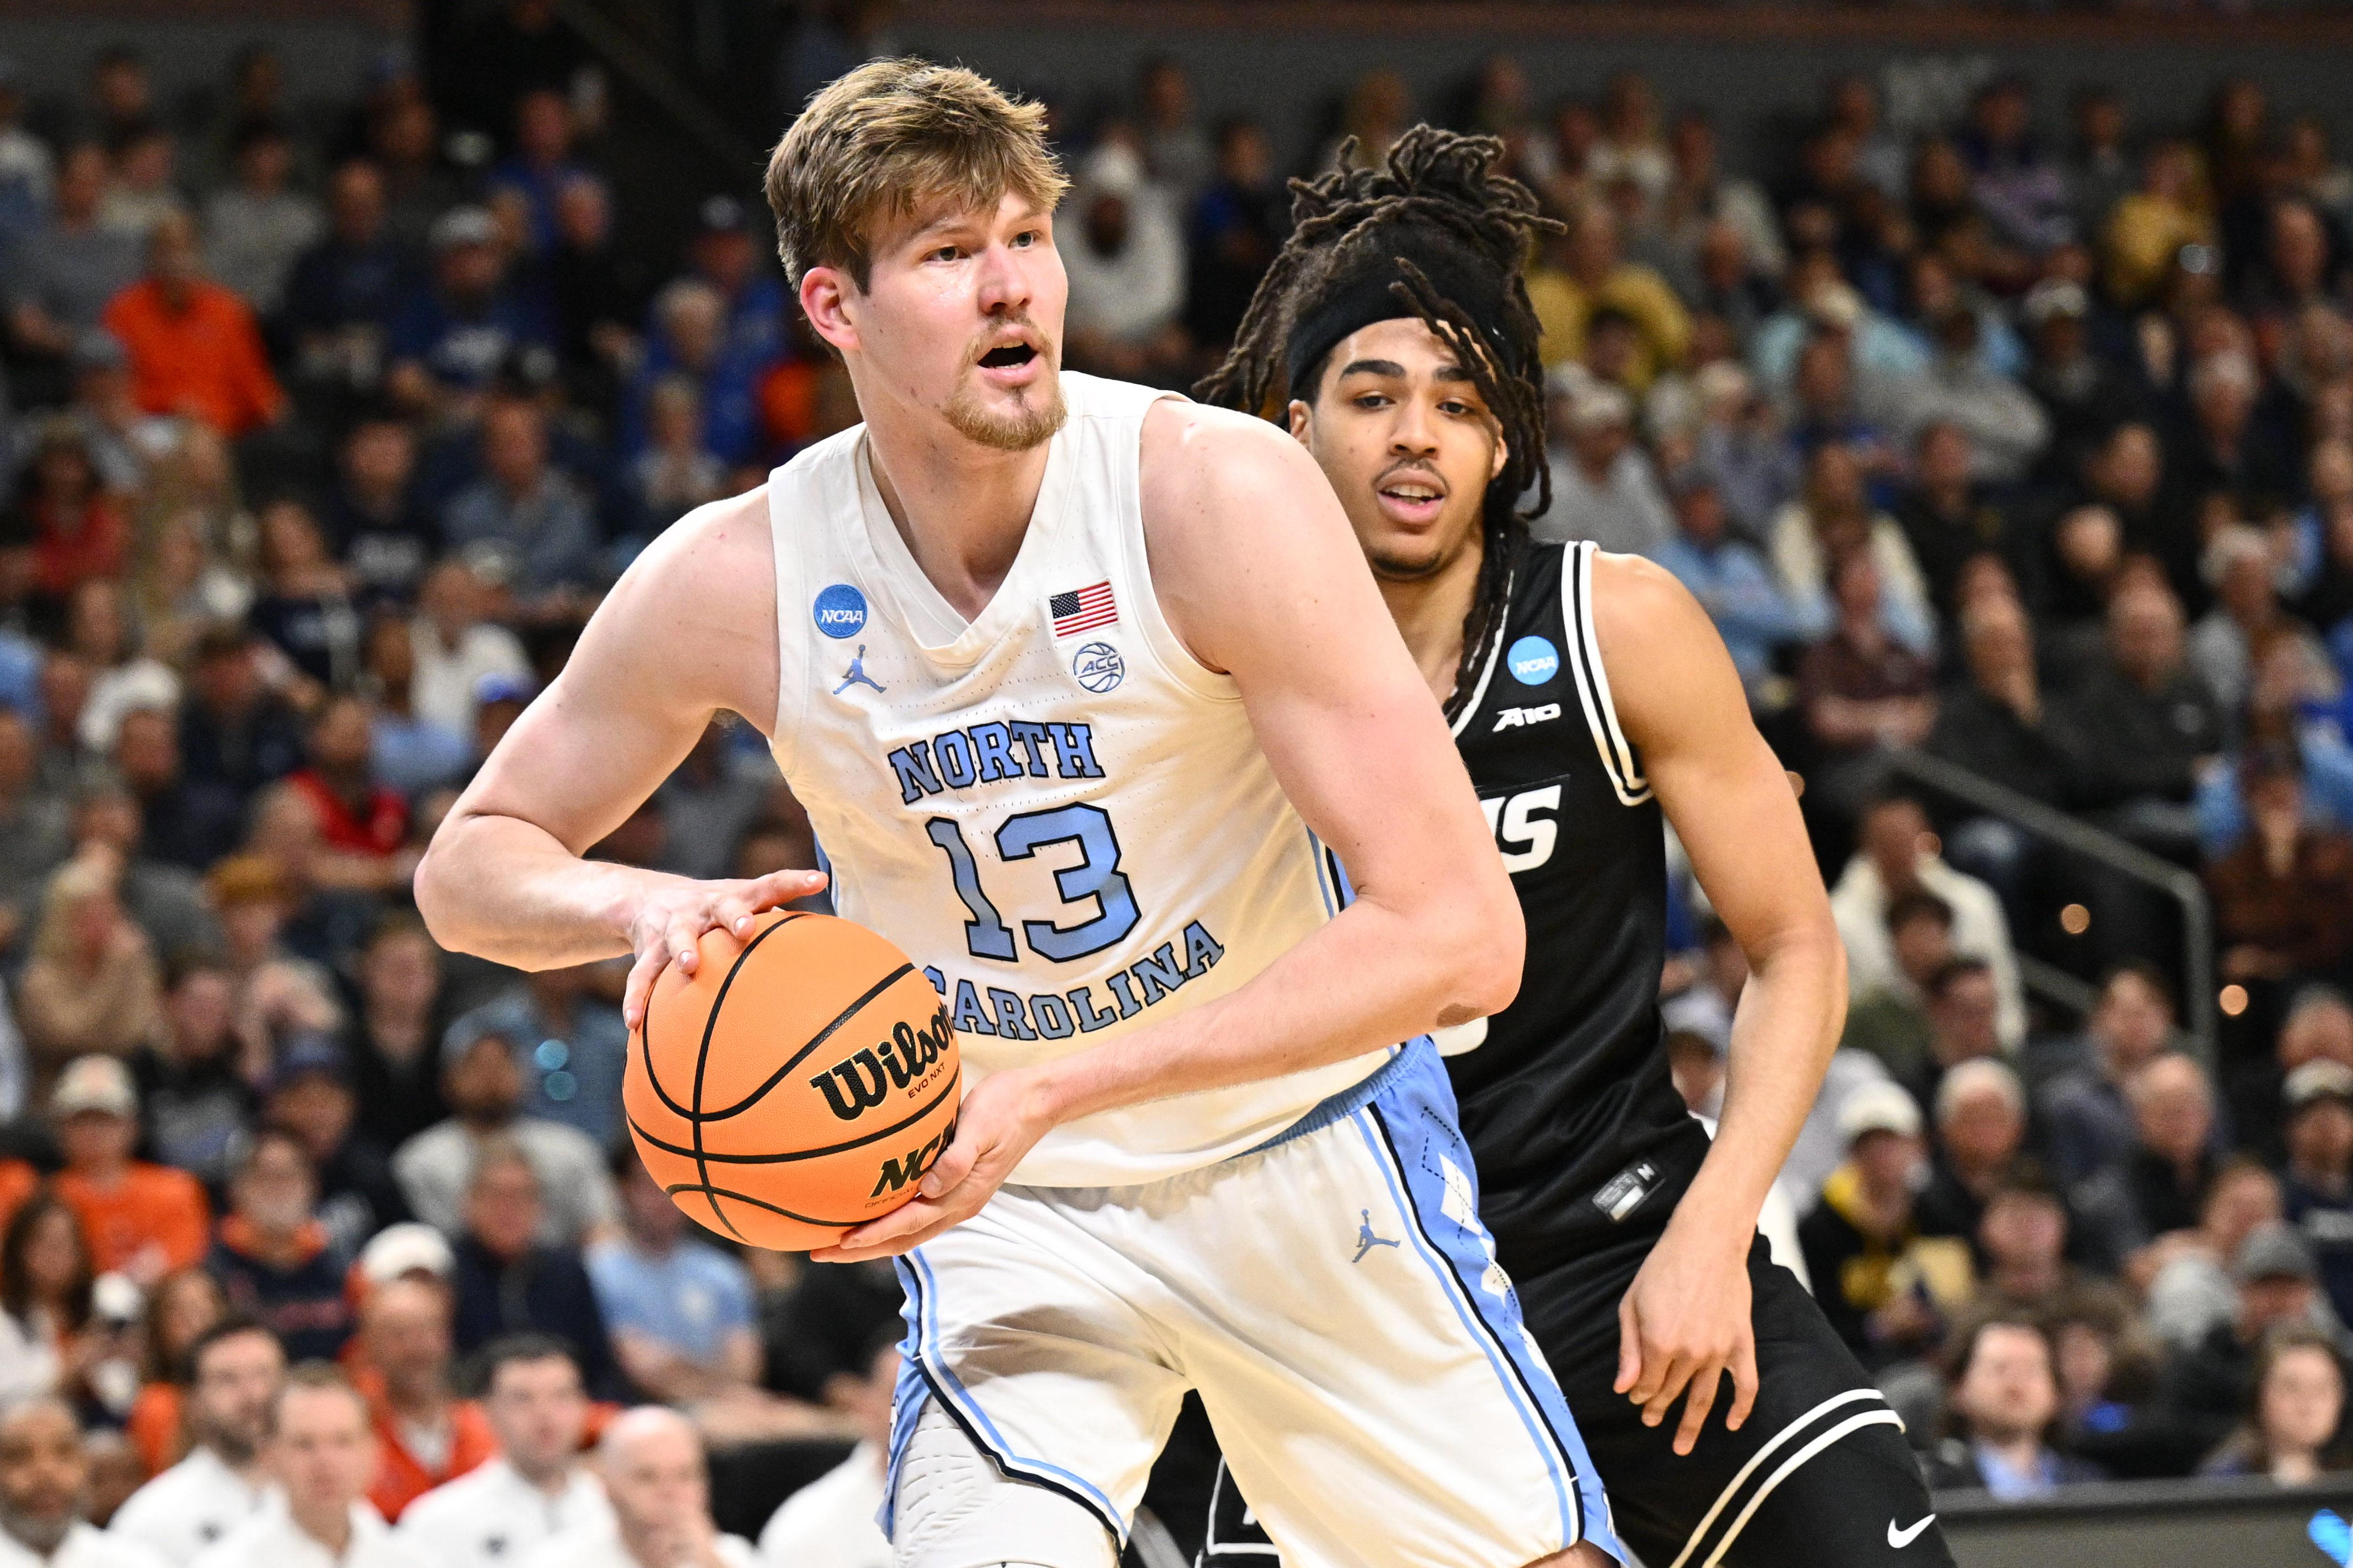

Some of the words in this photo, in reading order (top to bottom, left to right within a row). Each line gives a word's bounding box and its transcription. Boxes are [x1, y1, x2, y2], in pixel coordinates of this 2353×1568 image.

[820, 609, 864, 624] NCAA
[1081, 654, 1119, 673] ACC
[1516, 656, 1556, 675] NCAA
[1492, 703, 1561, 733] A10
[888, 720, 1105, 805] NORTH
[1480, 784, 1561, 874] S
[925, 801, 1142, 963] 13
[908, 1079, 929, 1099] EVO
[930, 1062, 946, 1081] NXT
[869, 1117, 957, 1198] NCA
